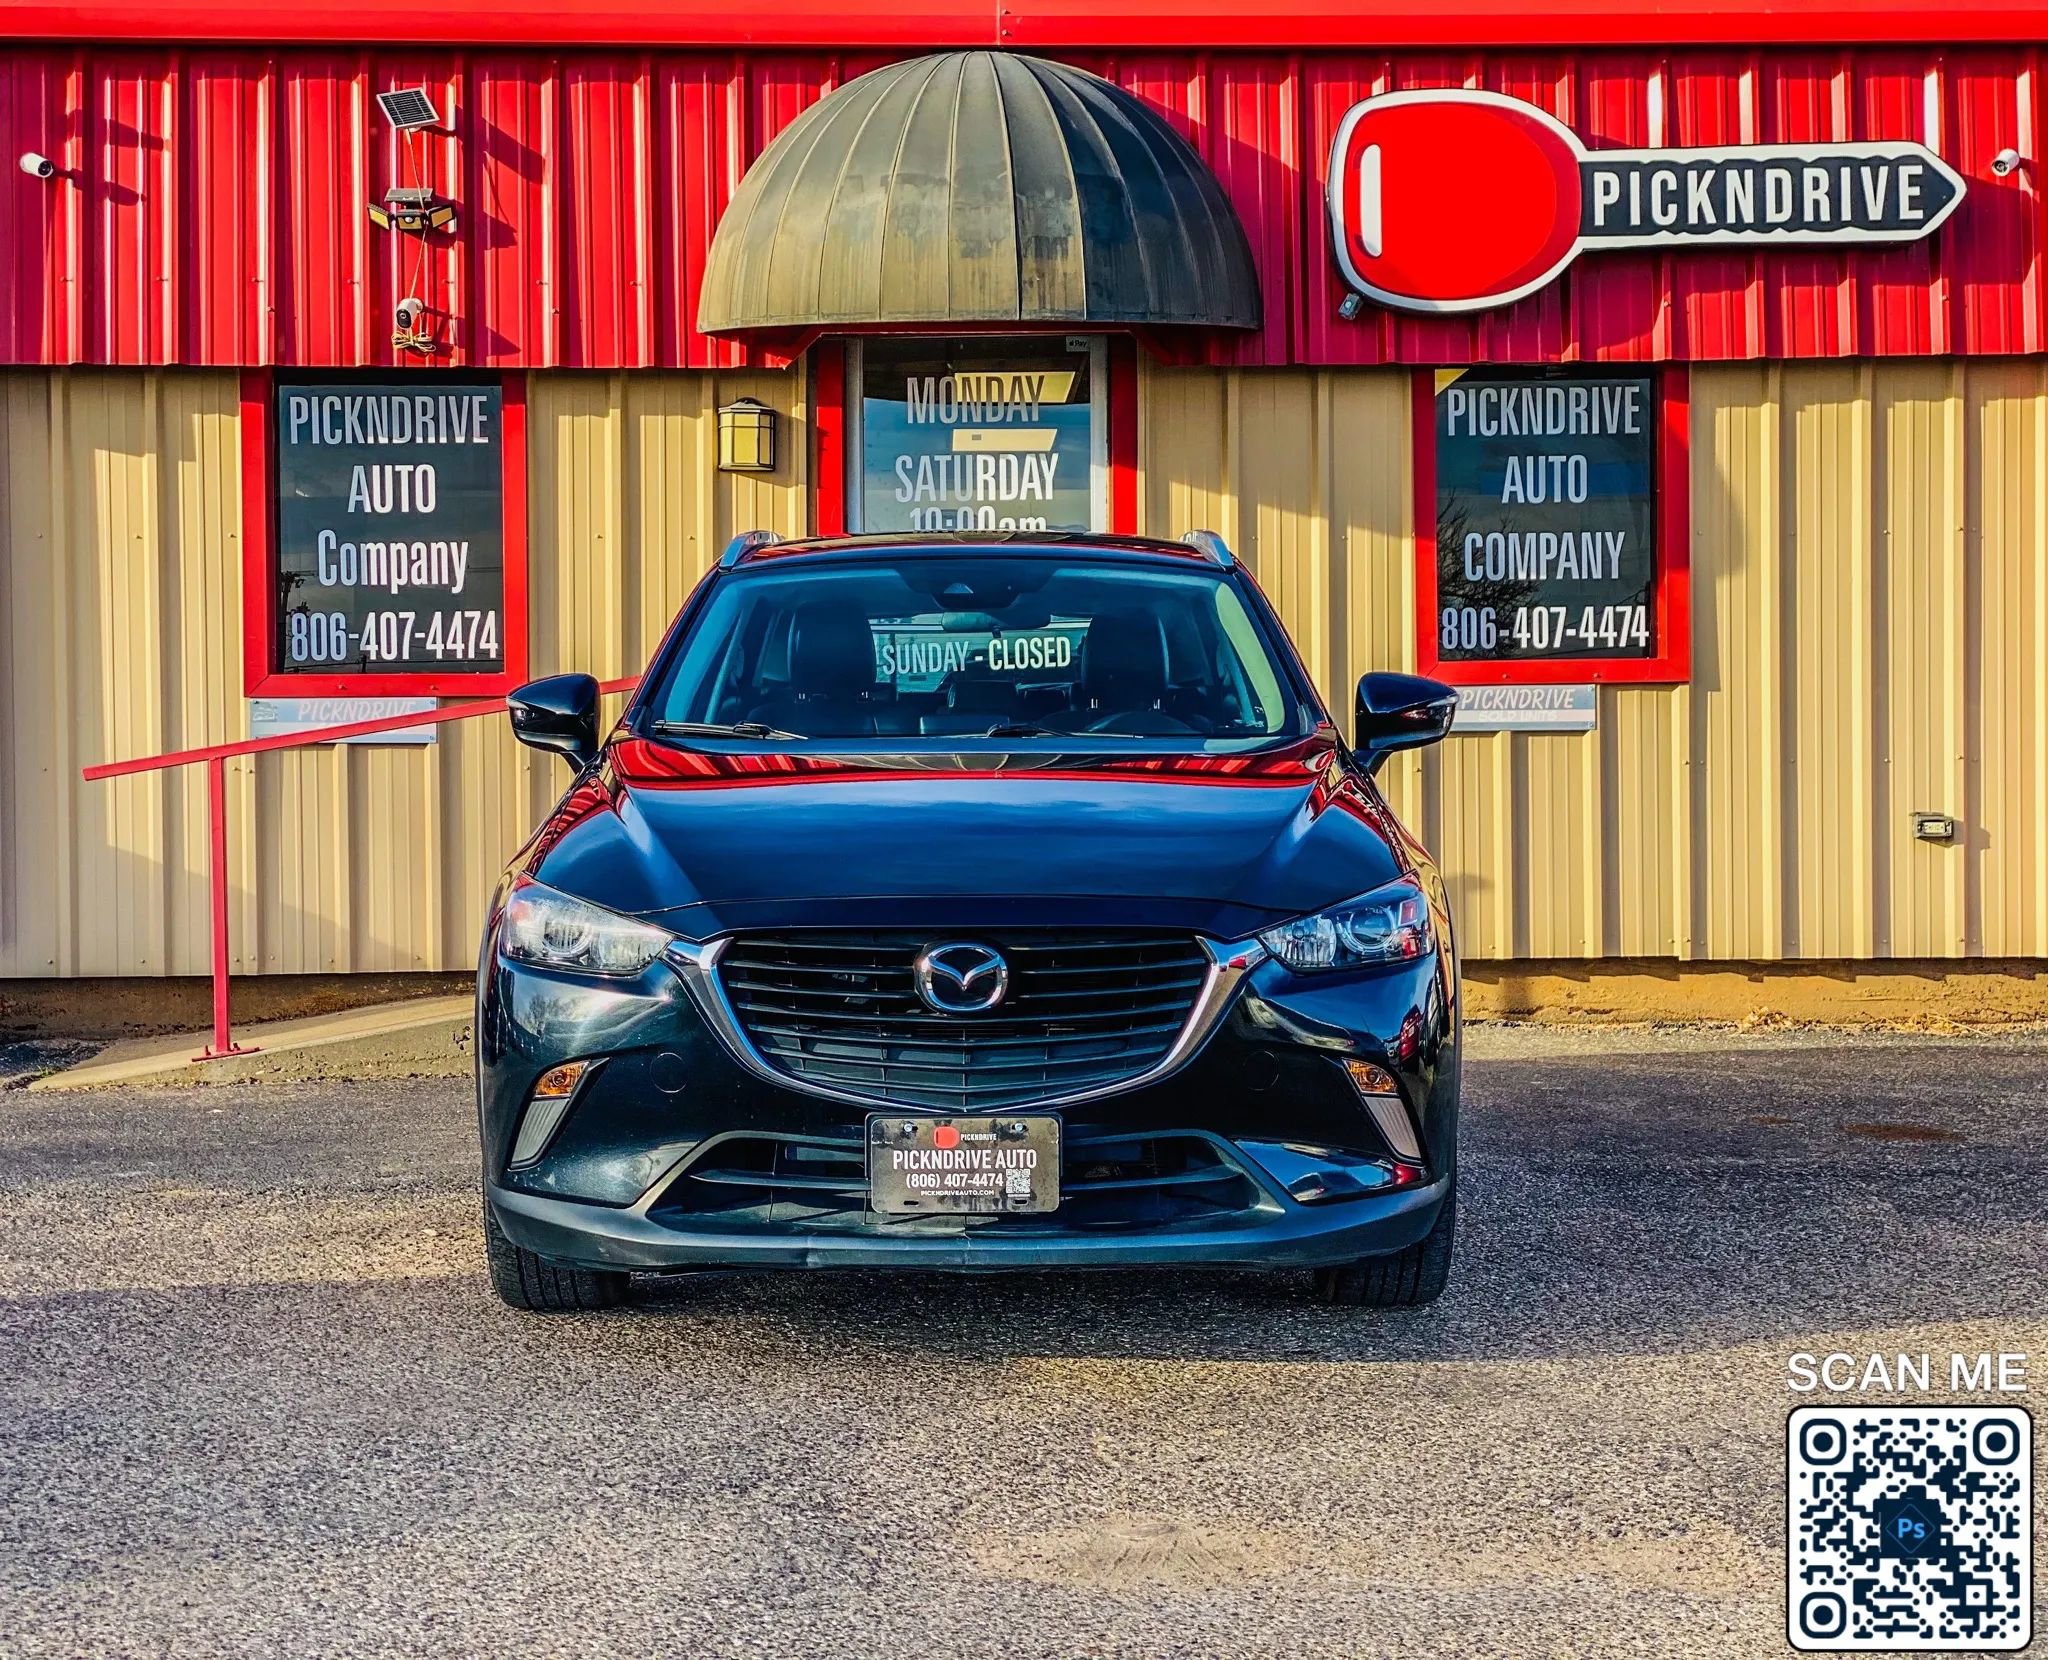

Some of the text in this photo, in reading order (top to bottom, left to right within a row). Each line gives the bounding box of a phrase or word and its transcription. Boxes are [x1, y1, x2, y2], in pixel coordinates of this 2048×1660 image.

[1593, 164, 1924, 227] PICKNDRIVE
[289, 395, 489, 445] PICKNDRIVE
[906, 375, 1045, 424] MONDAY
[1447, 386, 1641, 437] PICKNDRIVE
[347, 464, 437, 514] AUTO
[895, 453, 1059, 503] SATURDAY
[1501, 454, 1588, 504] AUTO
[317, 529, 469, 595] Company
[1463, 531, 1626, 582] COMPANY
[291, 610, 499, 662] 806-407-4474
[1441, 605, 1650, 650] 806-407-4474
[882, 641, 969, 675] SUNDAY
[988, 637, 1072, 671] CLOSED
[1461, 688, 1575, 710] PICKNDRIVE
[1478, 711, 1558, 722] SOLD UNITS
[893, 1149, 1037, 1169] PICKNDRIVE AUTO
[960, 1133, 997, 1141] PICKNDRIVE
[906, 1172, 1003, 1188] (806) 407-4474
